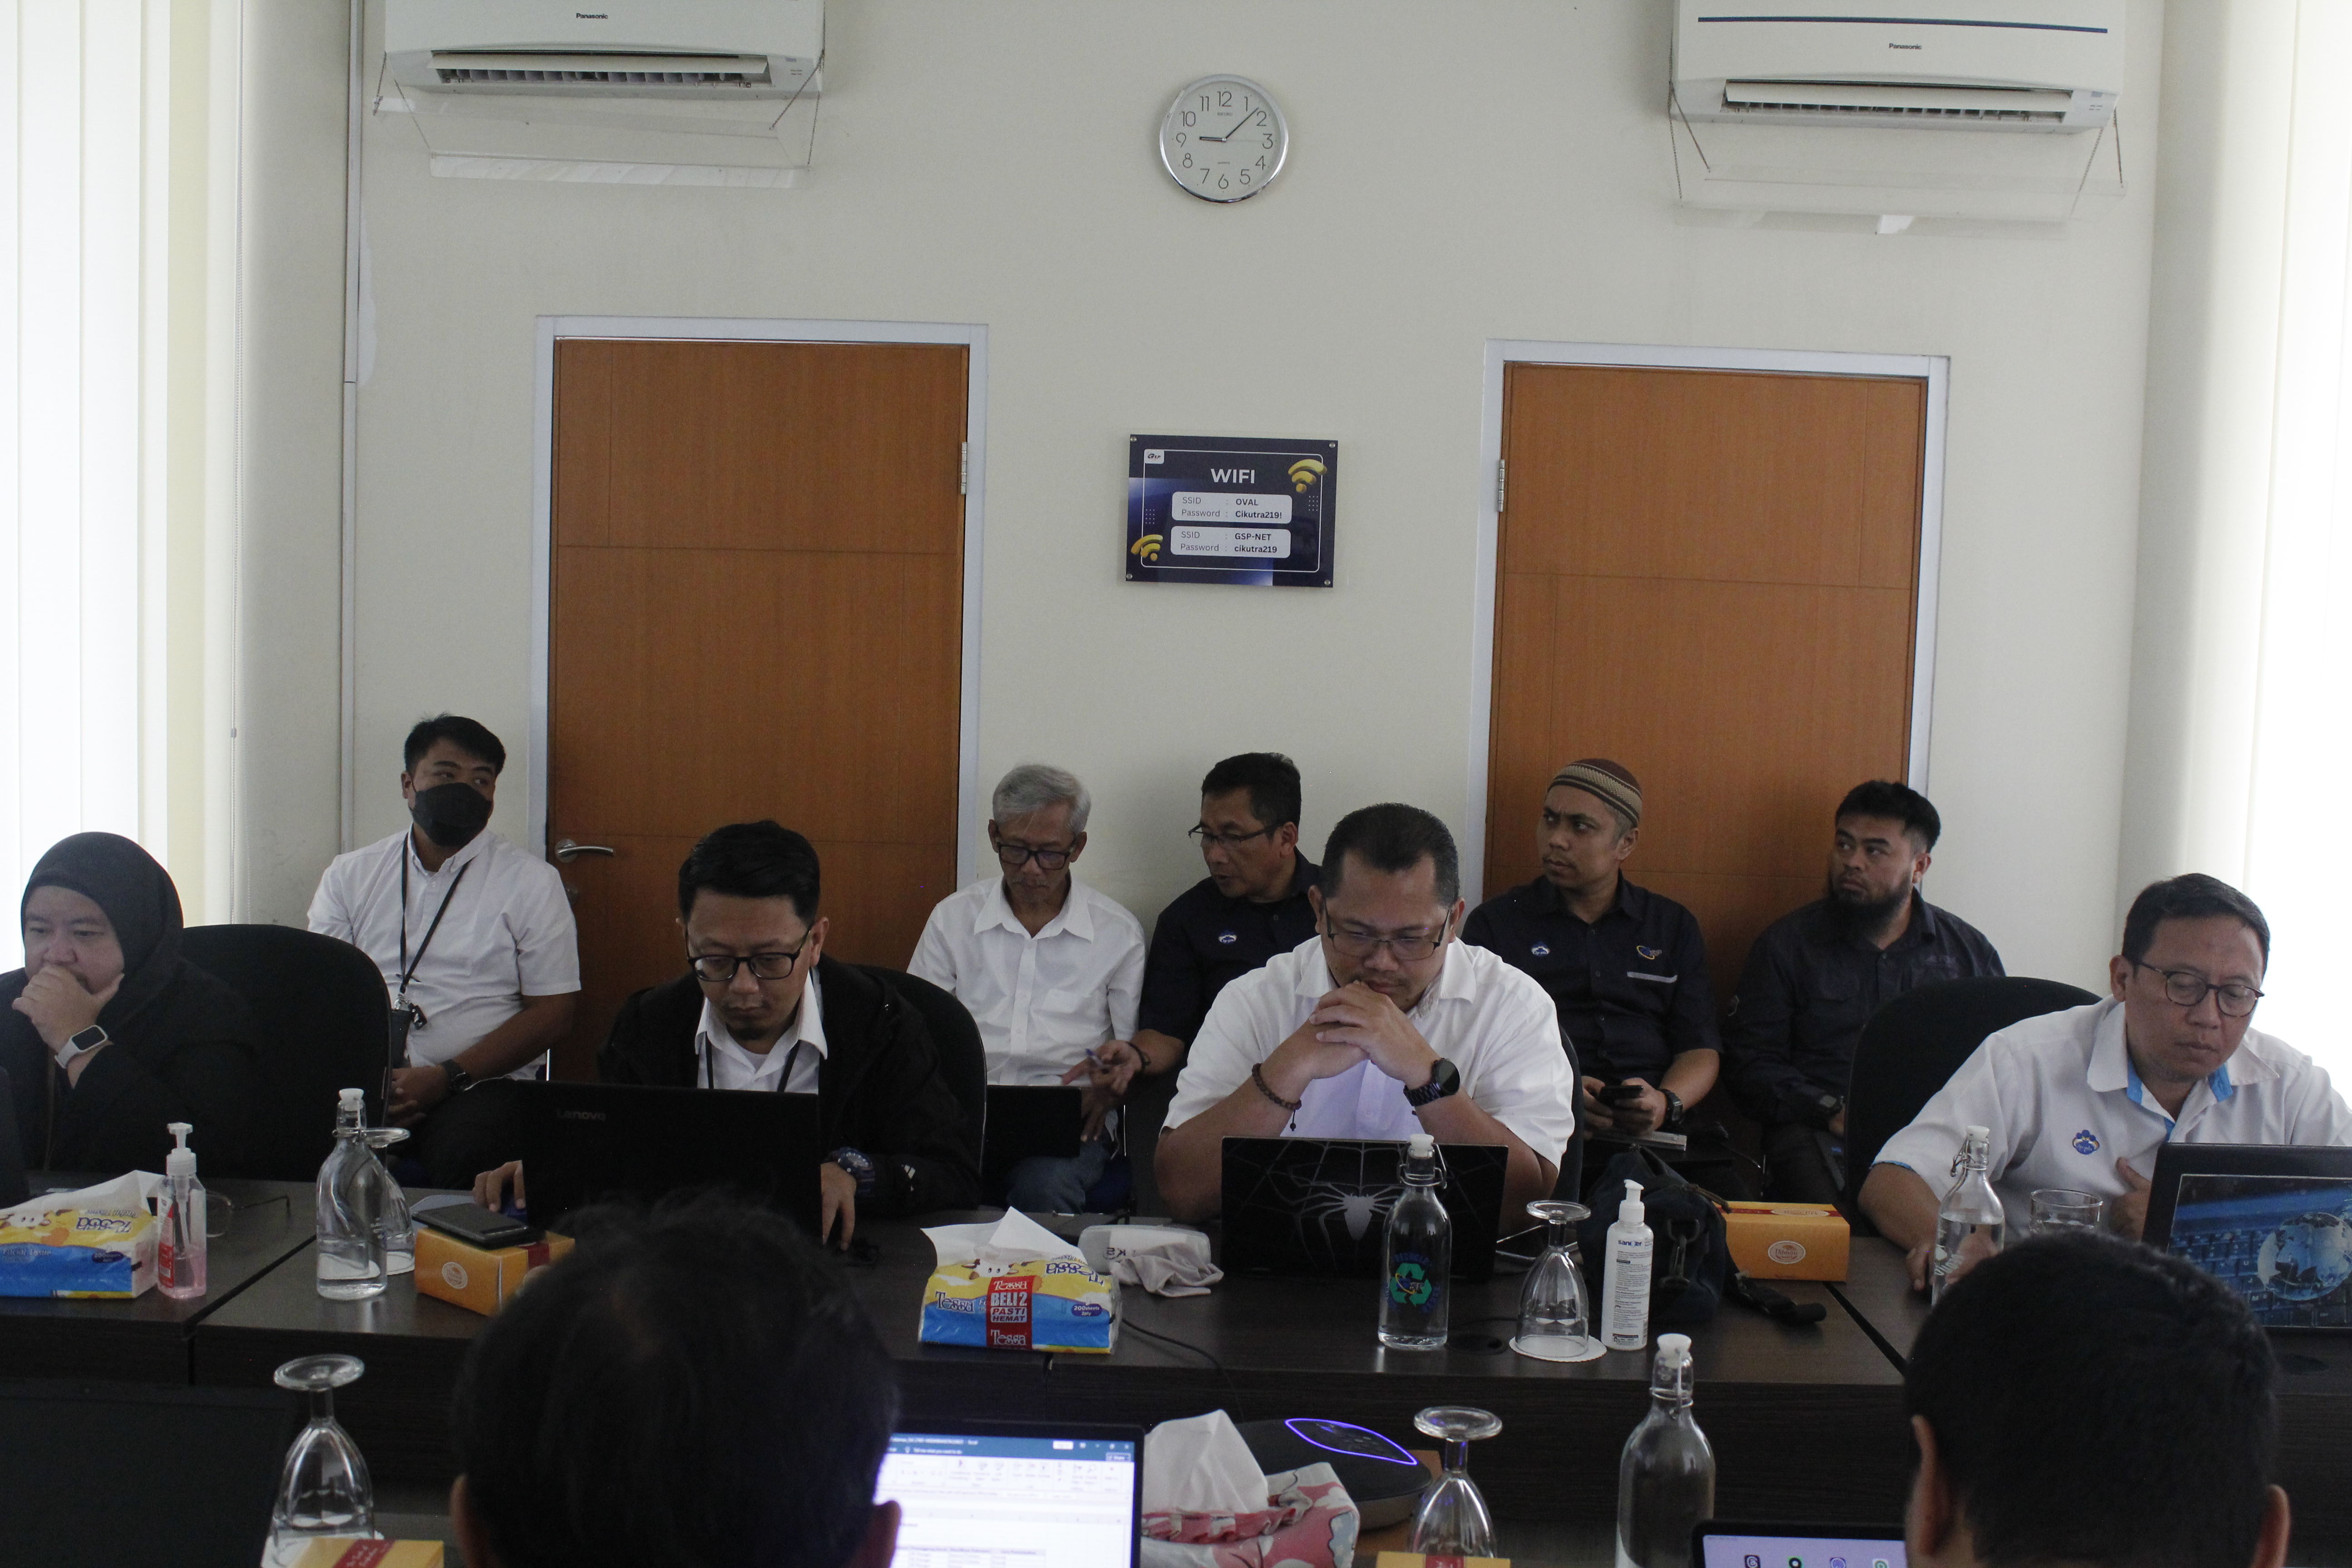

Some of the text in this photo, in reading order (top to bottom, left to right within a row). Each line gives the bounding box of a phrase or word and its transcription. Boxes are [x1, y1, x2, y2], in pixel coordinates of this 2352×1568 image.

[1200, 96, 1210, 111] 11
[1217, 91, 1232, 107] 12
[1244, 96, 1248, 112] 1
[1181, 111, 1196, 127] 10
[1256, 111, 1267, 126] 2
[1176, 132, 1186, 147] 9
[1262, 133, 1273, 149] 3
[1182, 153, 1193, 168] 8
[1255, 155, 1266, 170] 4
[1200, 168, 1210, 184] 7
[1218, 174, 1229, 189] 6
[1240, 169, 1250, 184] 5
[1210, 468, 1256, 484] WIFI
[1181, 509, 1220, 518] Password
[1235, 510, 1282, 519] Cikutra219!
[1235, 533, 1272, 541] GSP-NET
[1180, 544, 1220, 552] Password
[1234, 545, 1277, 553] cikutra219
[556, 1108, 606, 1120] Lenovo
[1046, 1262, 1104, 1287] Tessa
[994, 1280, 1028, 1291] Tessa
[936, 1290, 975, 1313] Tessa
[990, 1328, 1026, 1346] Tessa
